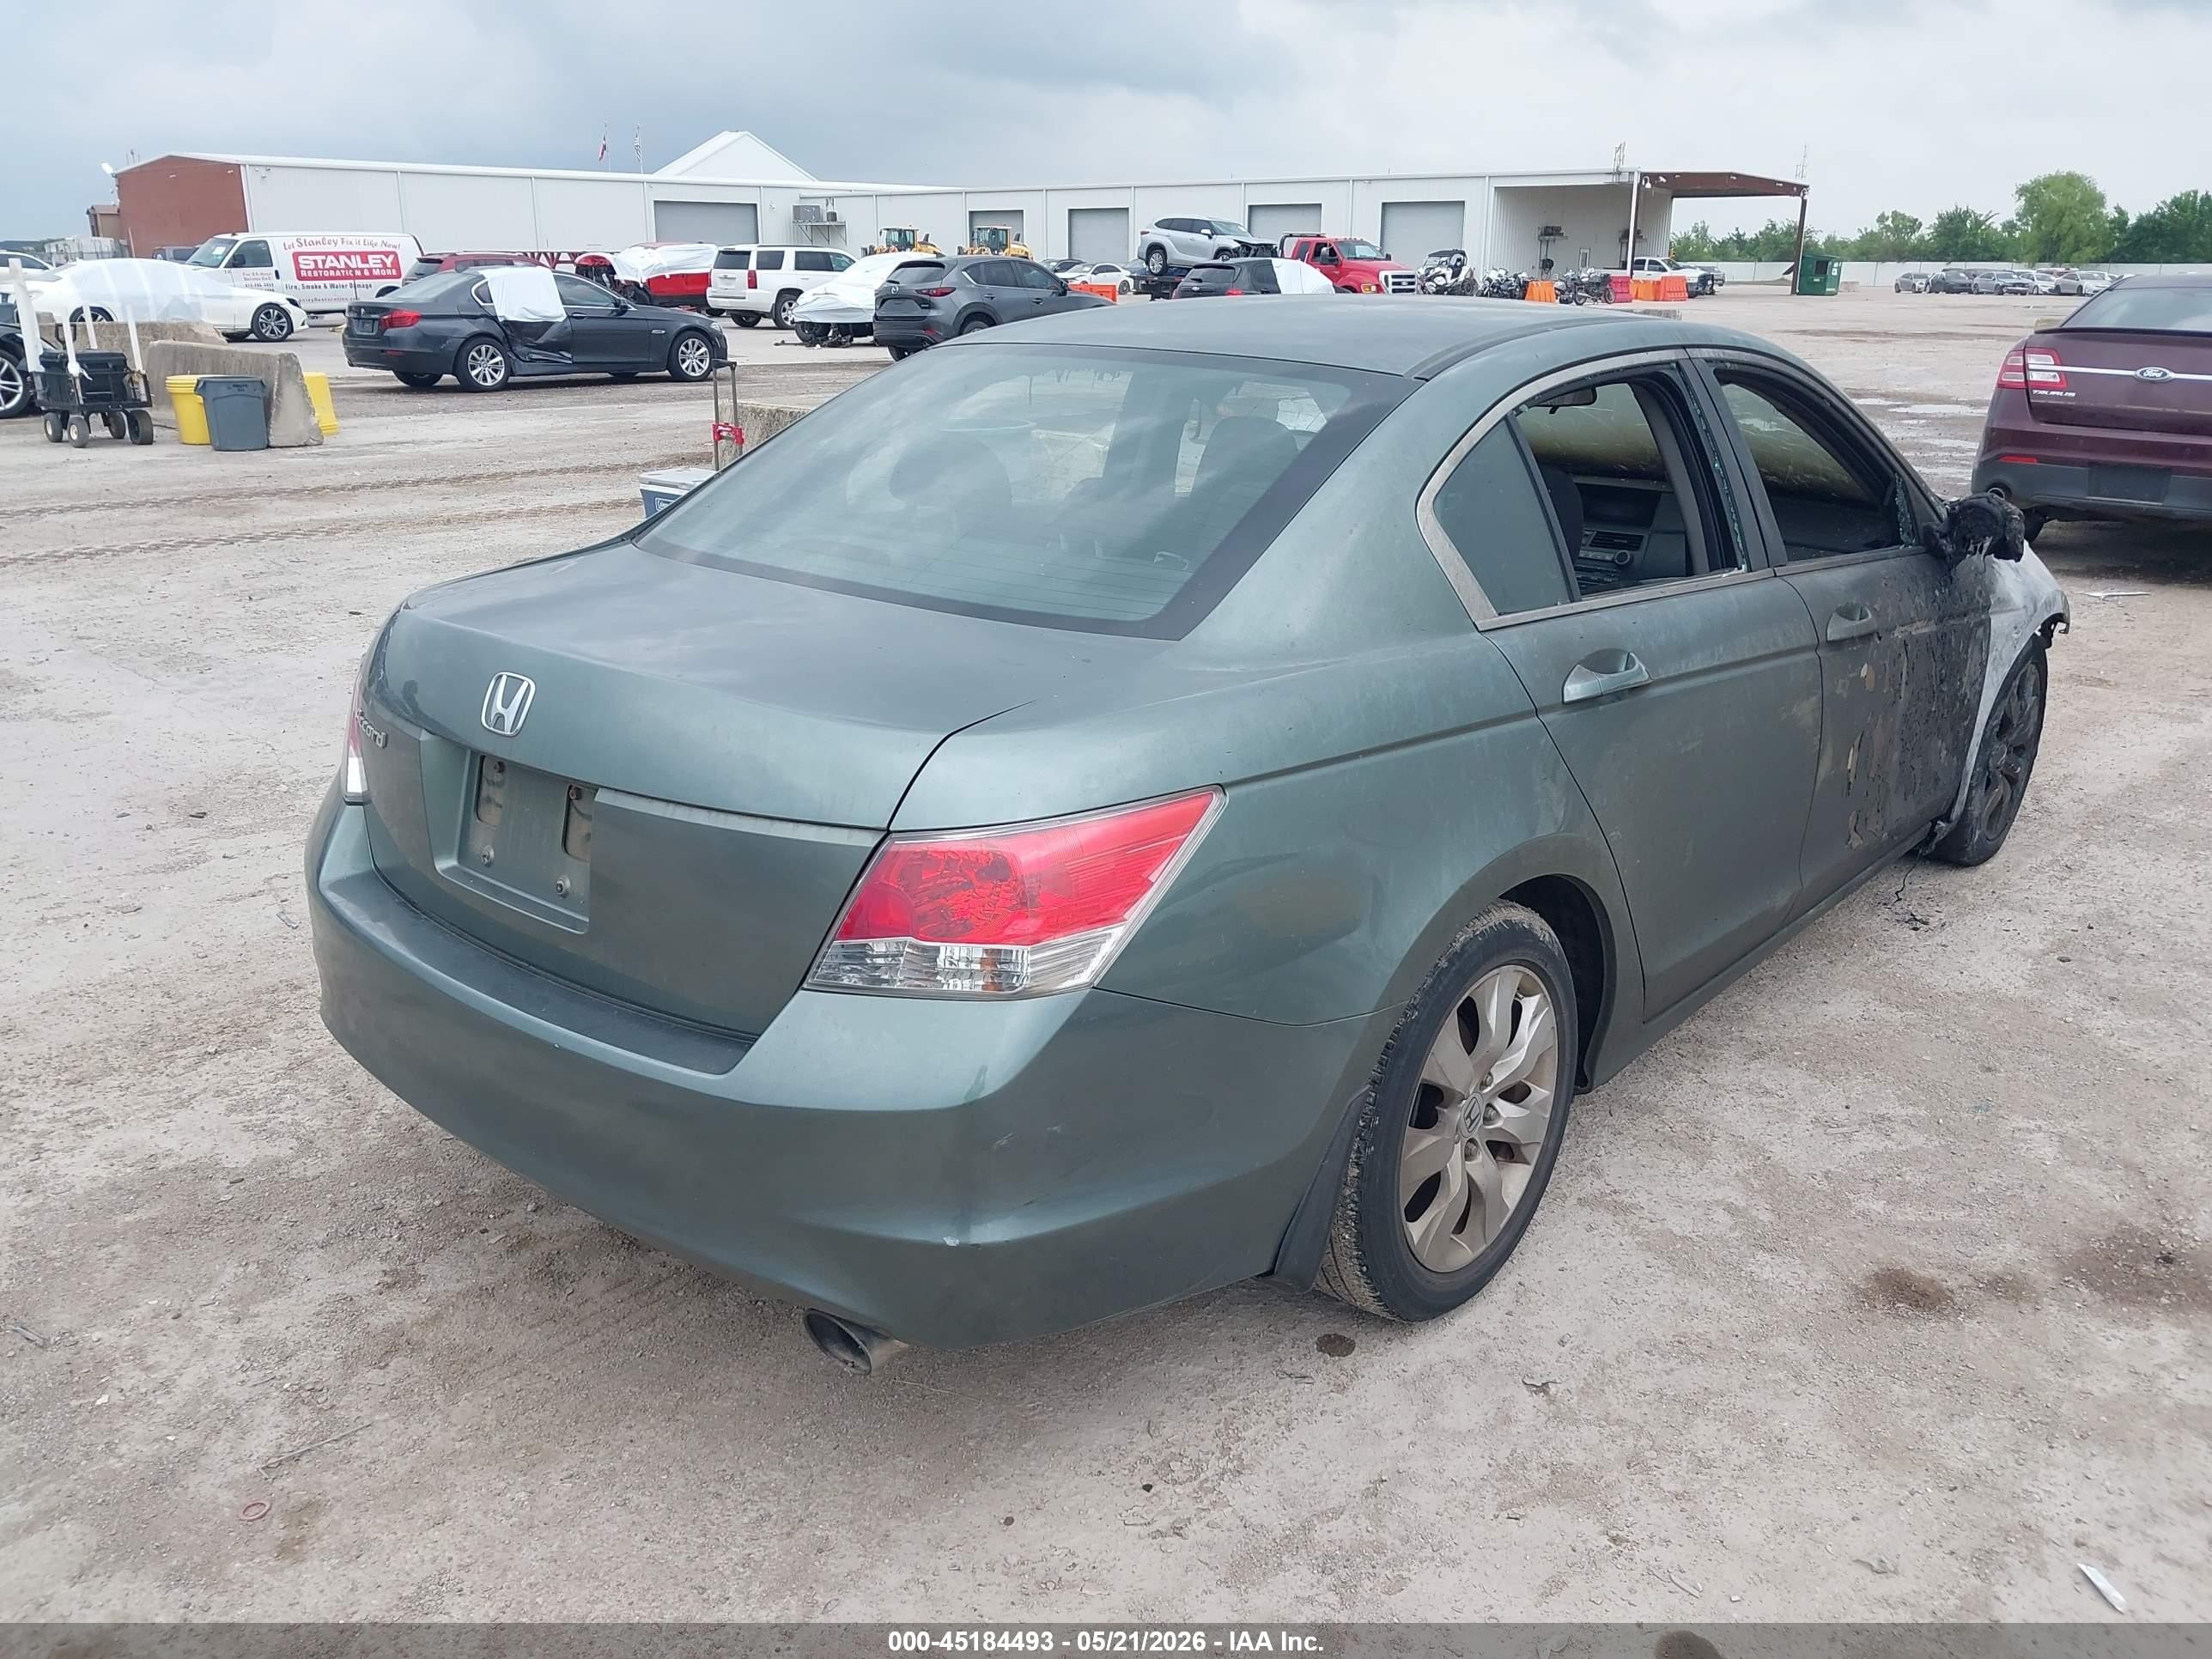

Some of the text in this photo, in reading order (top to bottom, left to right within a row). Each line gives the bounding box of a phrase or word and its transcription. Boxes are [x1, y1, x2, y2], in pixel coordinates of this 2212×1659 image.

[295, 237, 338, 247] Stanley
[340, 237, 353, 246] Fix
[363, 238, 378, 247] Like
[298, 254, 395, 269] STANLEY
[301, 269, 362, 277] RESTORATION
